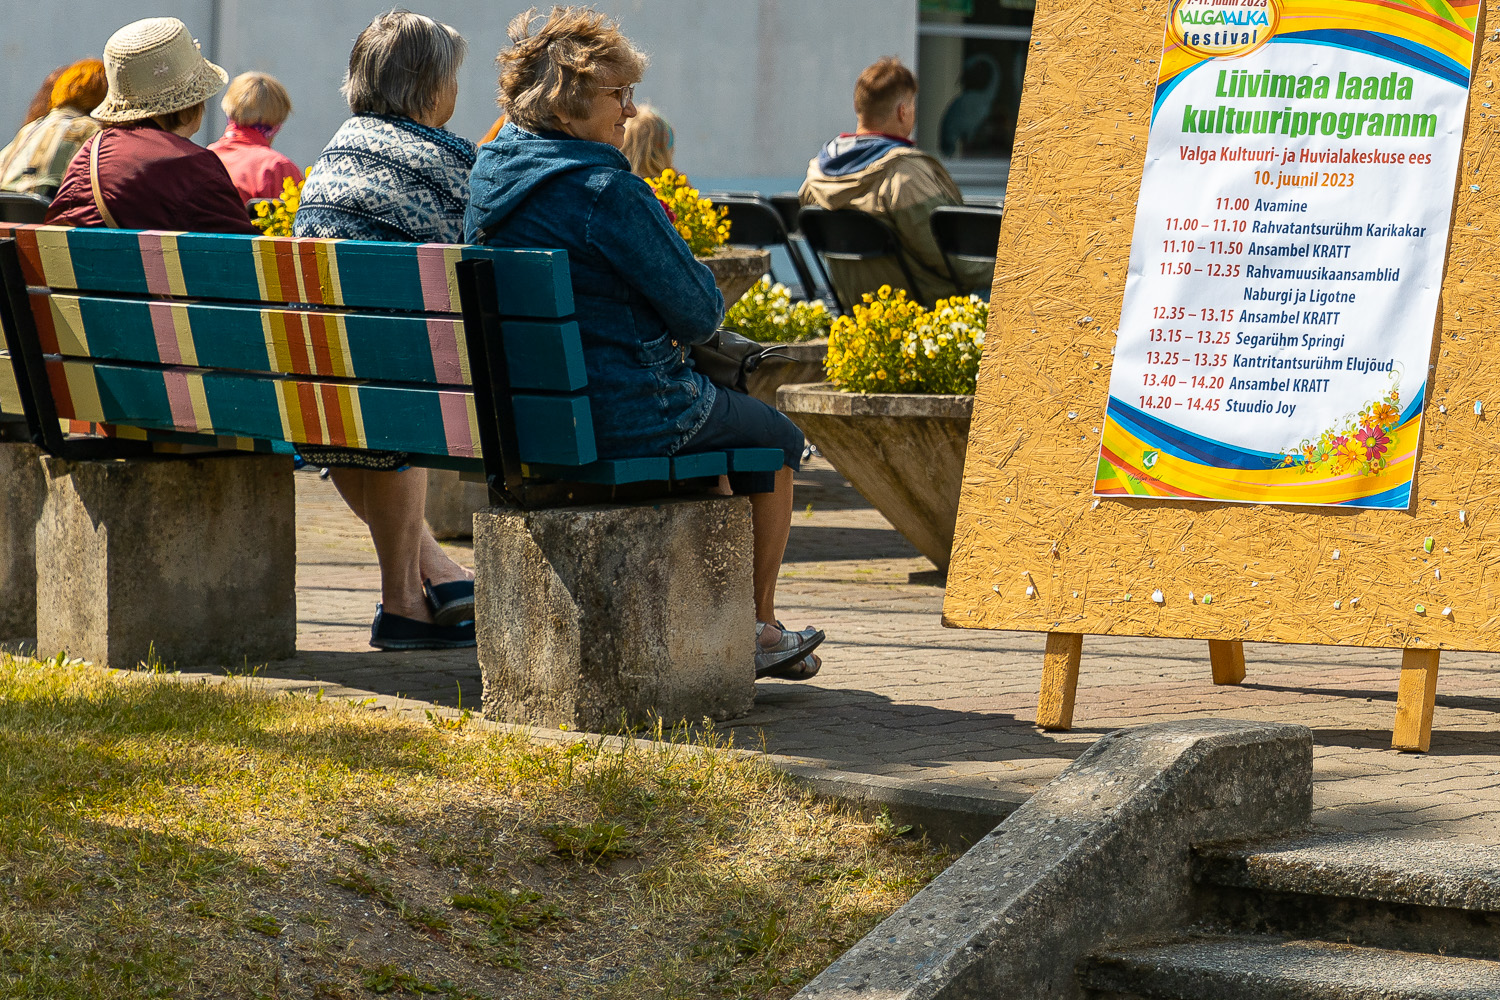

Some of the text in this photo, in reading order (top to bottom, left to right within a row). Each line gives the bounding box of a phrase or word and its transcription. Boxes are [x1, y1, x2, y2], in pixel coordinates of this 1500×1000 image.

[1179, 9, 1269, 26] VALGAVALKA
[1183, 29, 1257, 46] festival
[1215, 69, 1414, 100] Liivimaa laada
[1182, 104, 1437, 140] kultuuriprogramm
[1179, 145, 1432, 166] Valga Kultuuri- ja Huvialakeskuse ees
[1254, 170, 1354, 189] 10. juunil 2023
[1215, 197, 1308, 213] 11.00 Avamine
[1165, 218, 1199, 231] 11.00
[1213, 219, 1247, 233] 11.10
[1251, 220, 1363, 237] Rahvatantsurühm
[1366, 223, 1427, 238] Karikakar
[1162, 240, 1195, 253] 11.10
[1209, 241, 1243, 255] 11.50
[1248, 242, 1310, 258] Ansambel
[1312, 244, 1351, 259] KRATT
[1160, 262, 1192, 276] 11.50
[1206, 263, 1241, 278] 12.35
[1245, 264, 1400, 282] Rahvamuusikaansamblid
[1243, 287, 1356, 306] Naburgi ja Ligotne
[1152, 306, 1186, 320] 12.35
[1200, 308, 1234, 322] 13.15
[1239, 310, 1300, 324] Ansambel
[1302, 311, 1341, 325] KRATT
[1149, 328, 1182, 342] 13.15
[1197, 330, 1231, 345] 13.25
[1235, 331, 1299, 349] Segarühm
[1301, 333, 1345, 350] Springi
[1146, 351, 1179, 365] 13.25
[1194, 353, 1228, 367] 13.35
[1233, 353, 1343, 370] Kantritantsurühm
[1346, 357, 1394, 375] Elujõud
[1143, 373, 1177, 387] 13.40
[1191, 375, 1225, 389] 14.20
[1229, 376, 1291, 392] Ansambel
[1293, 378, 1330, 393] KRATT
[1139, 395, 1172, 409] 14.20
[1187, 397, 1221, 411] 14.45
[1225, 399, 1273, 414] Stuudio
[1275, 400, 1297, 417] Joy
